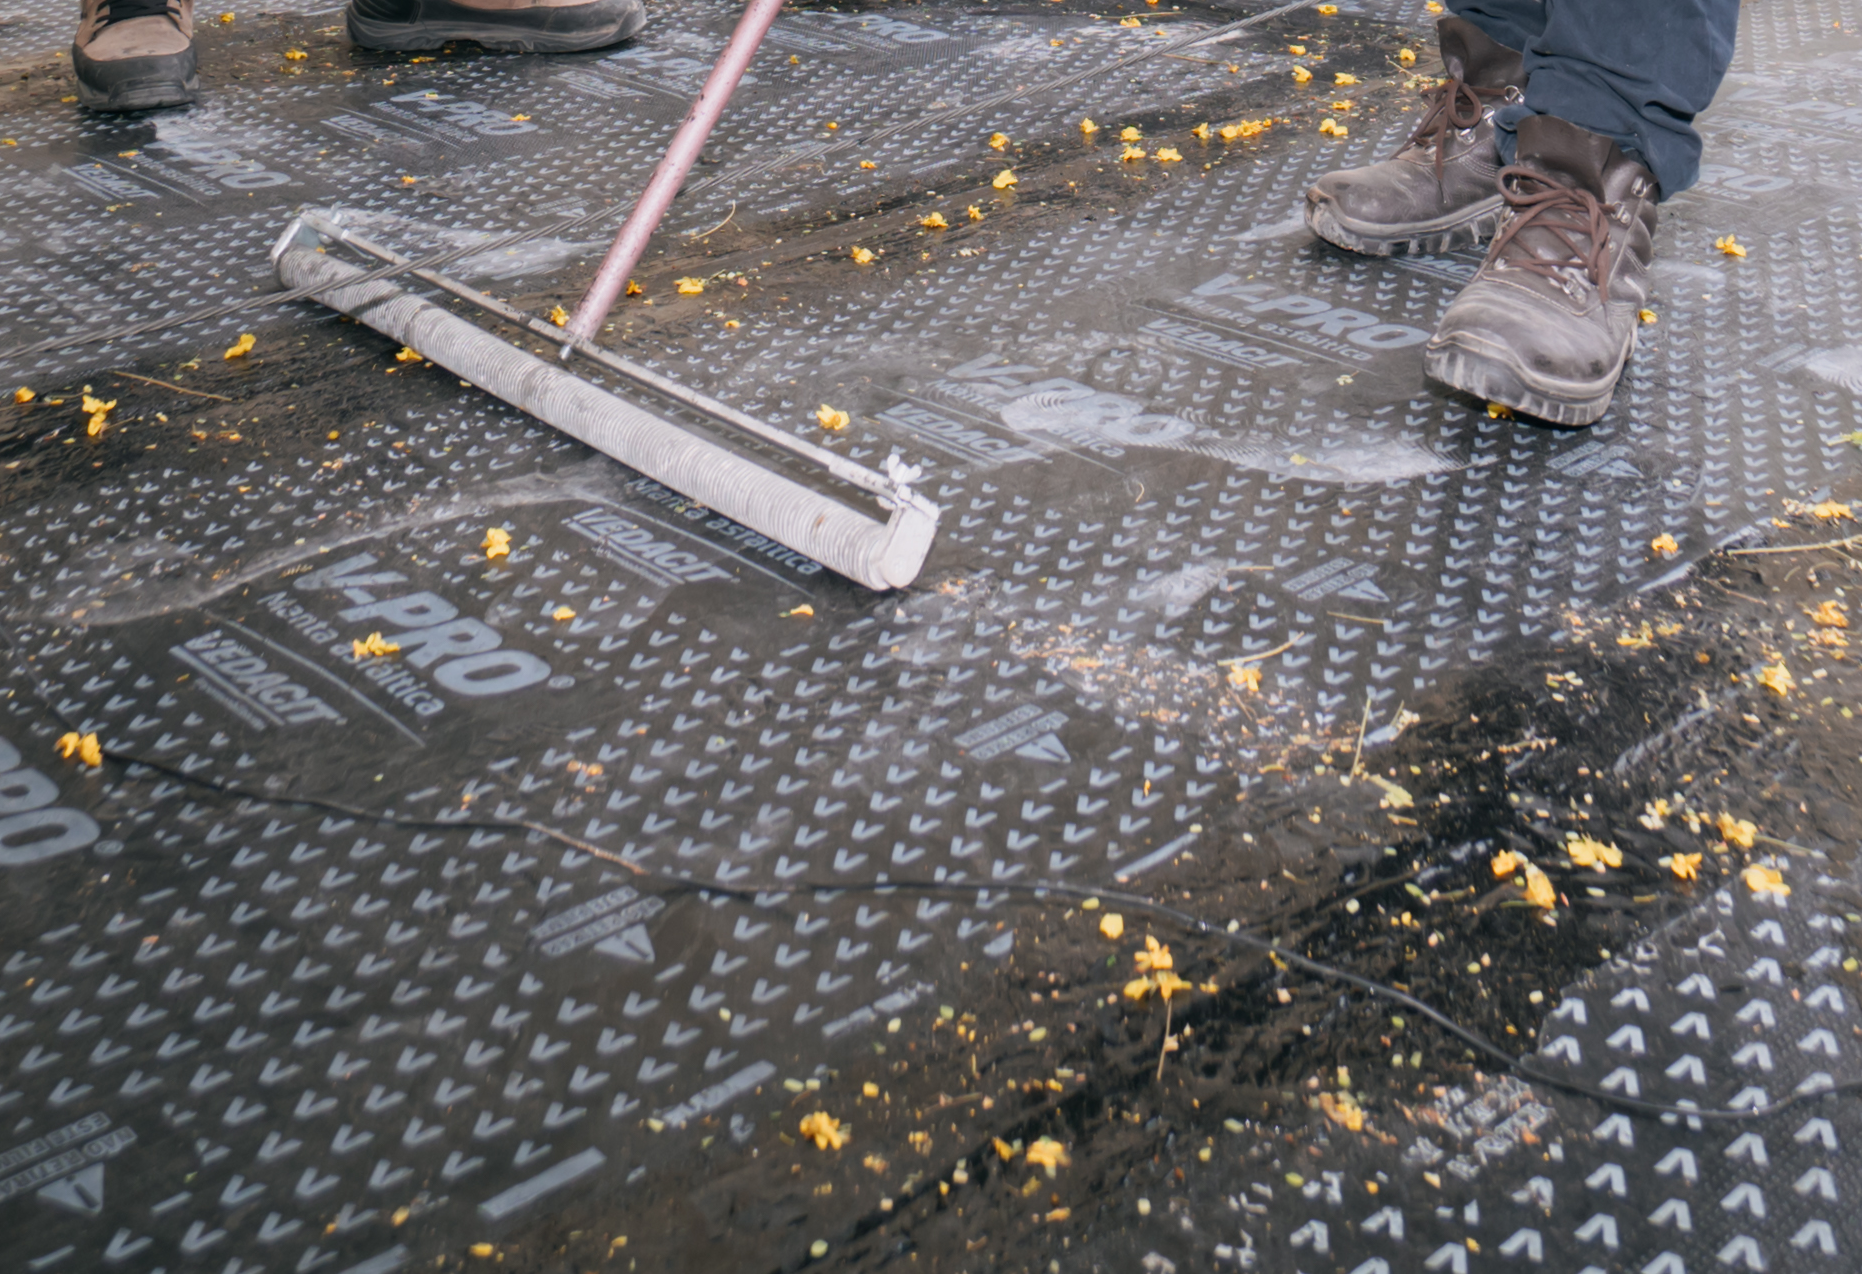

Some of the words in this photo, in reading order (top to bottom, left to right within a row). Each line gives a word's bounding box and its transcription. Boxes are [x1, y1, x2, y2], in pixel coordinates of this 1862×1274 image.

[389, 88, 539, 136] V-PRO
[71, 162, 164, 200] VEDACIT
[1191, 272, 1432, 350] V-PRO
[1145, 318, 1305, 368] VEDACIT
[1257, 321, 1374, 362] asfáltica
[886, 402, 1045, 464] VEDACIT
[573, 507, 734, 583] VEDACIT
[255, 590, 340, 646] Manta
[292, 552, 552, 697] V-PRO
[184, 629, 342, 726] VEDACIT
[44, 1111, 112, 1147] ESTE
[82, 1125, 138, 1159] NÃO
